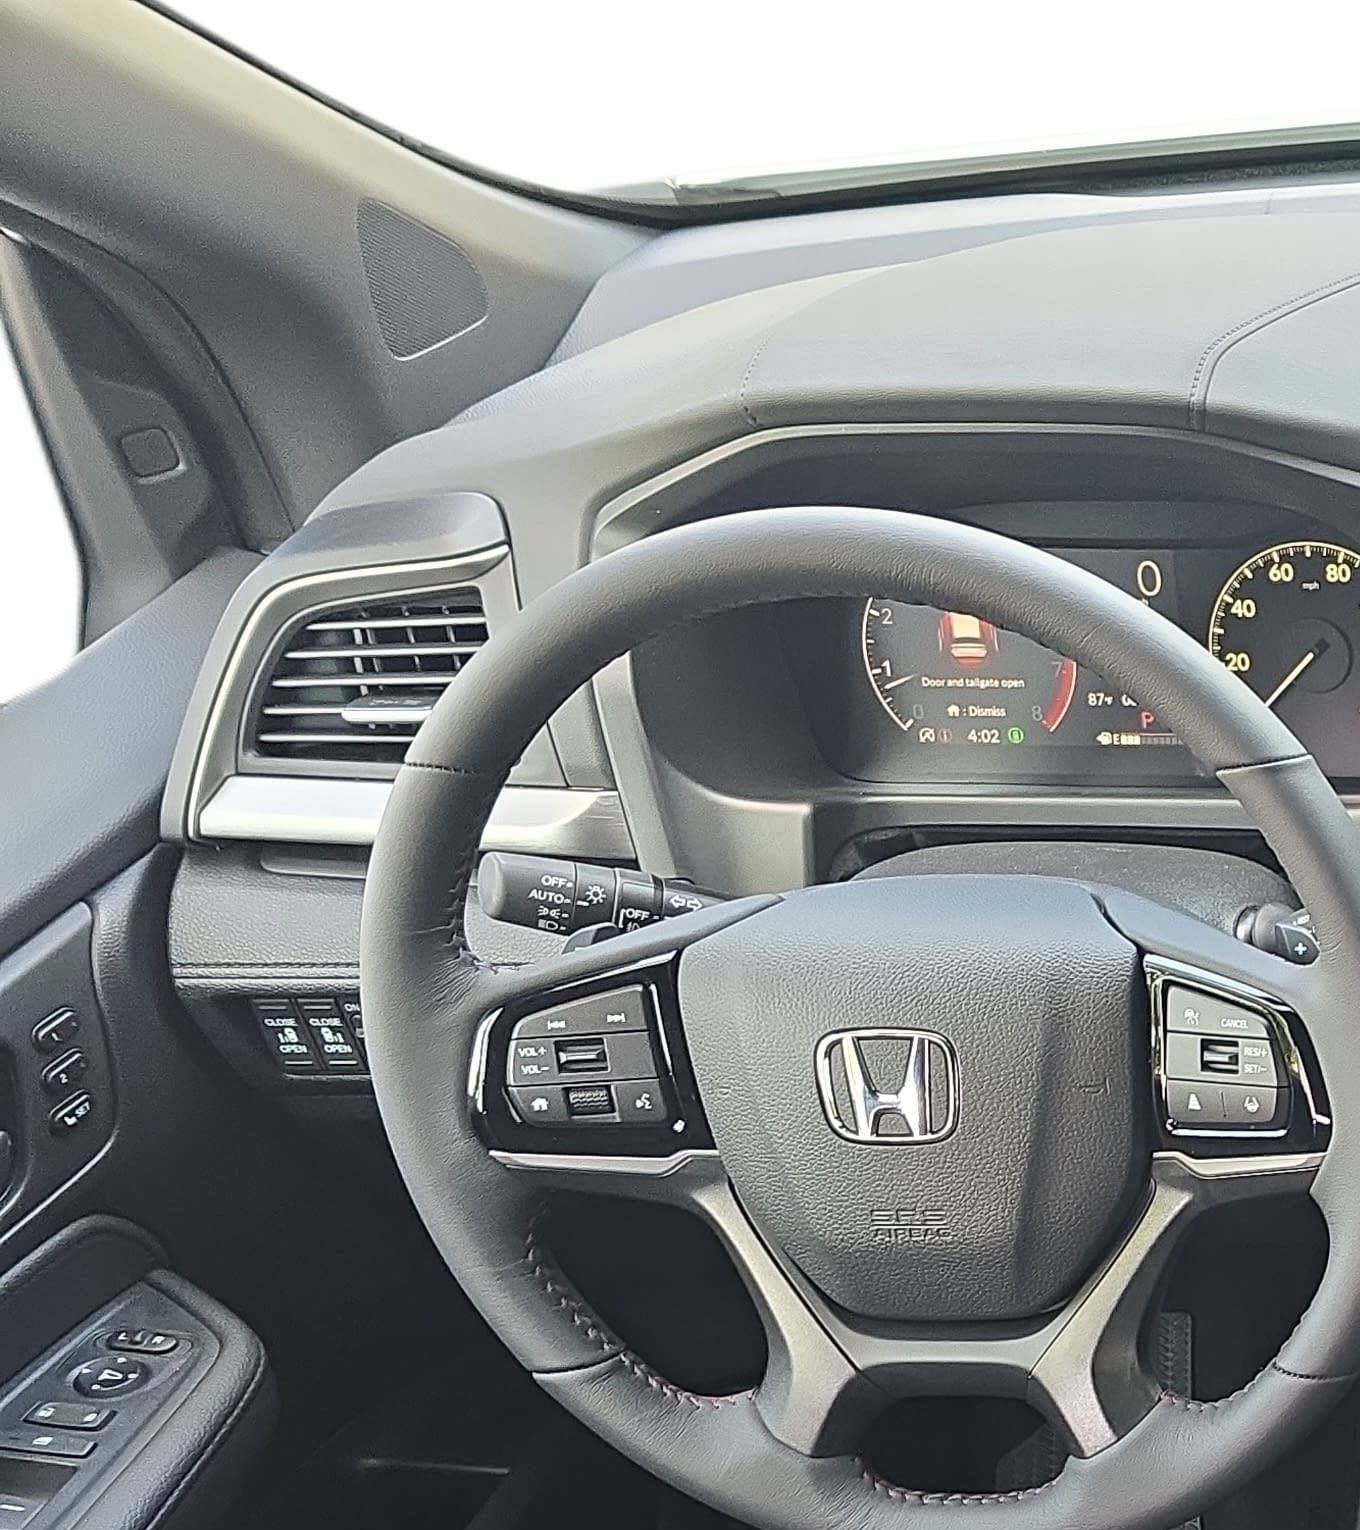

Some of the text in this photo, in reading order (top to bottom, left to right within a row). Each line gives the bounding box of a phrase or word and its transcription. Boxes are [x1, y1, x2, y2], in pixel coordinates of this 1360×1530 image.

[1137, 560, 1162, 597] 0
[1268, 565, 1294, 582] 60
[1325, 565, 1351, 583] 80
[1302, 581, 1320, 591] mph
[1231, 599, 1256, 618] 40
[881, 608, 893, 625] 2
[1225, 653, 1250, 671] 20
[922, 677, 1025, 689] Door and tailgate open
[969, 705, 1006, 716] Dismiss
[967, 730, 1000, 744] 4:02
[541, 875, 567, 888] OFF
[528, 889, 565, 903] AUTO
[625, 908, 650, 920] OFF
[1220, 1018, 1248, 1029] CANCEL
